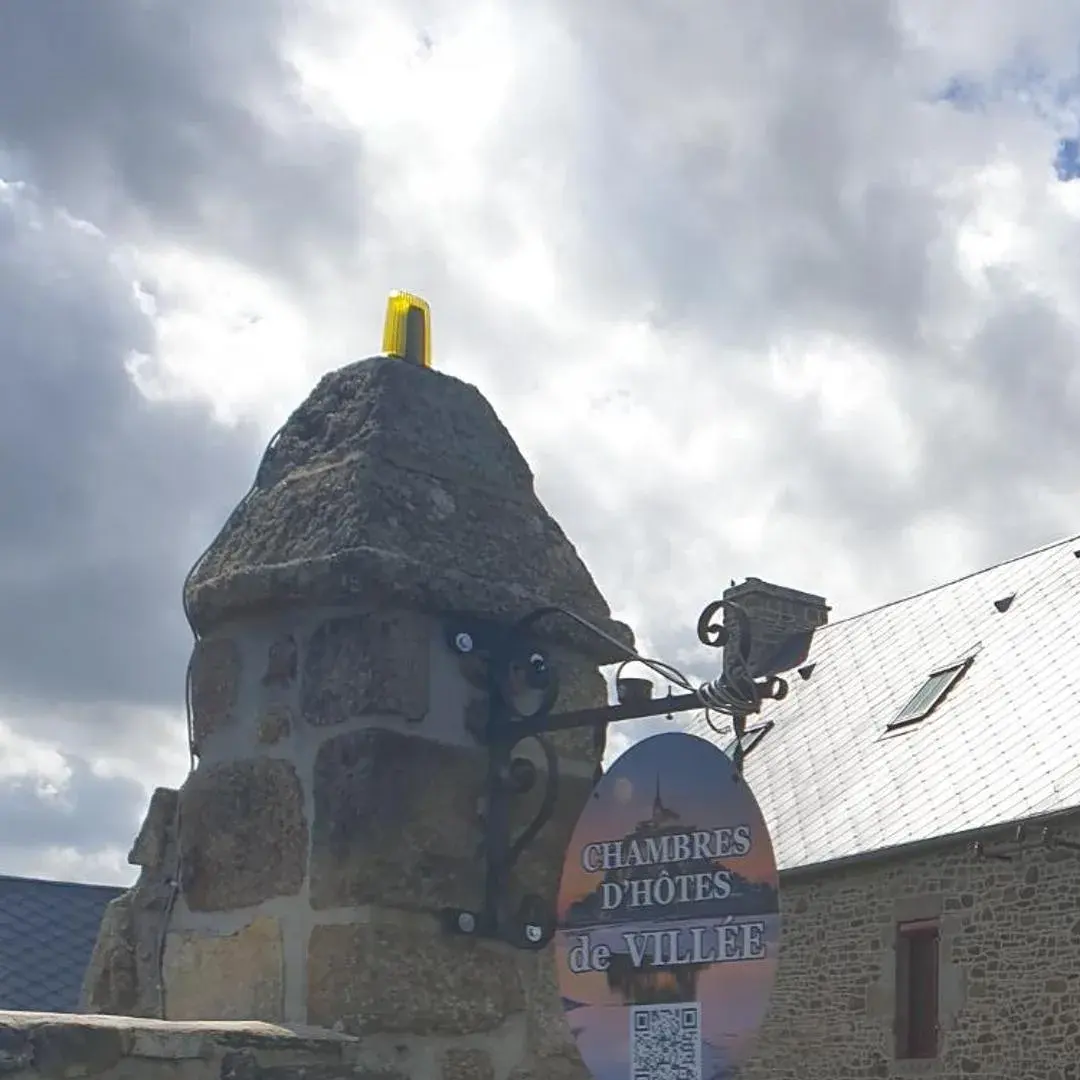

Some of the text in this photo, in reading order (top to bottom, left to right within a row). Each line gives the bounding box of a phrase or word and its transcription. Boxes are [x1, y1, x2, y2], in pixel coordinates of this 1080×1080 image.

[583, 826, 750, 872] CHAMBRES
[603, 871, 732, 909] D'HÔTES
[570, 916, 765, 973] de VILLÉE
